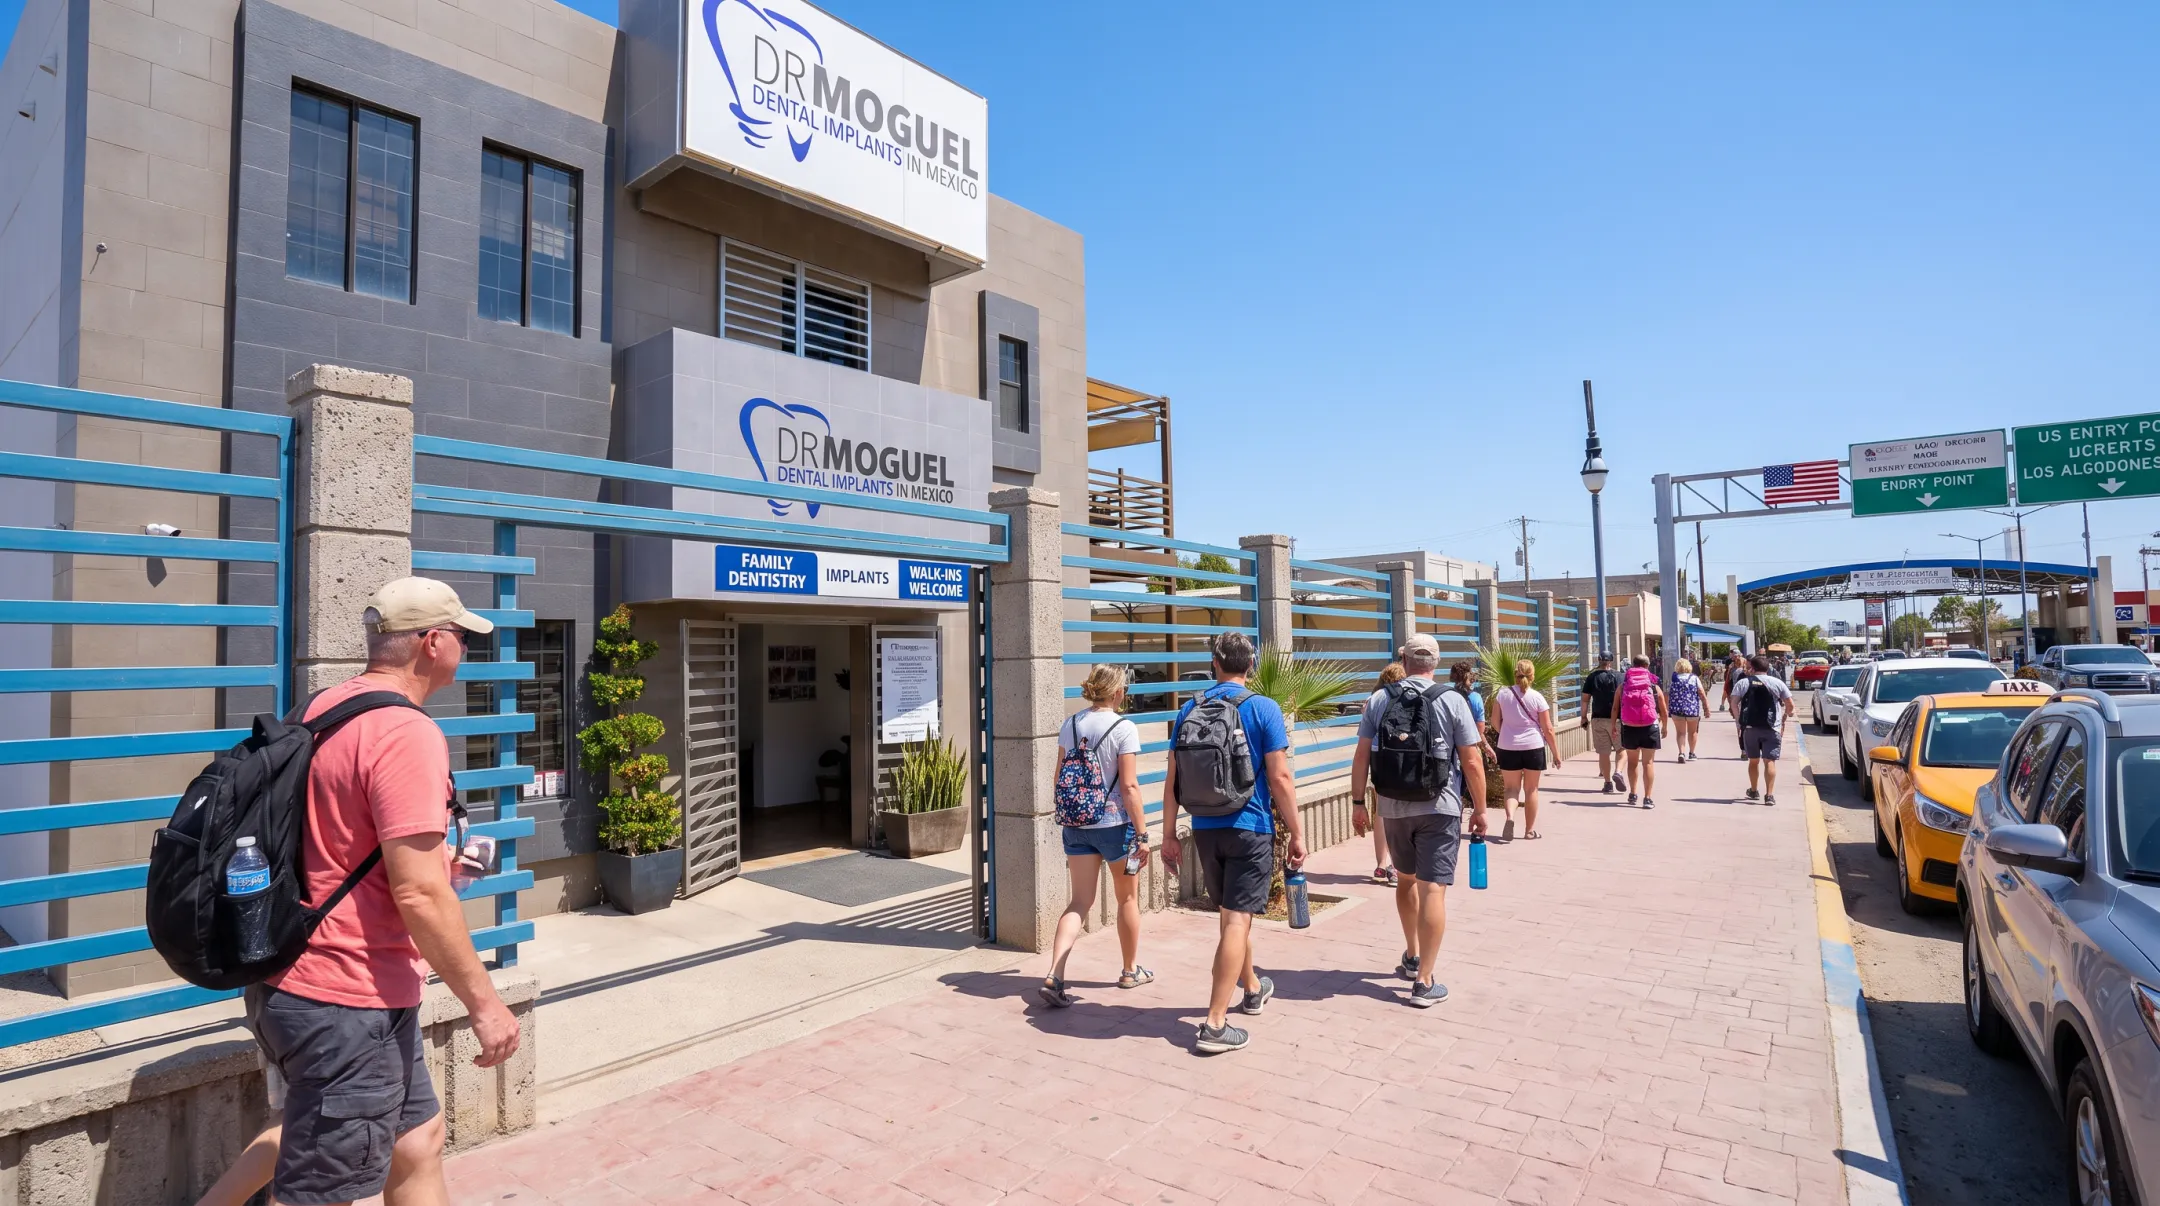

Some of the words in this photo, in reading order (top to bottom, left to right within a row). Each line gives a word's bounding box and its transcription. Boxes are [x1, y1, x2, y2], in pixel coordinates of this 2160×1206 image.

[754, 35, 806, 101] DR
[813, 63, 979, 181] MOGUEL
[753, 84, 819, 131] DENTAL
[824, 115, 902, 166] IMPLANTS
[906, 152, 921, 175] IN
[926, 165, 978, 200] MEXICO
[2038, 430, 2062, 443] US
[2070, 423, 2130, 440] ENTRY
[778, 427, 818, 468] DR
[823, 435, 955, 488] MOGUEL
[2023, 466, 2055, 479] LOS
[2061, 456, 2160, 477] ALGODONES
[778, 466, 829, 487] DENTAL
[832, 474, 894, 496] IMPLANTS
[896, 482, 909, 498] IN
[911, 486, 954, 504] MEXICO
[1881, 477, 1927, 491] ENDRY
[1933, 474, 1975, 487] POINT
[741, 552, 793, 570] FAMILY
[728, 570, 807, 588] DENTISTRY
[826, 568, 889, 584] IMPLANTS
[909, 566, 962, 581] WALK-INS
[909, 582, 963, 597] WELCOME
[2000, 682, 2040, 692] TAXE
